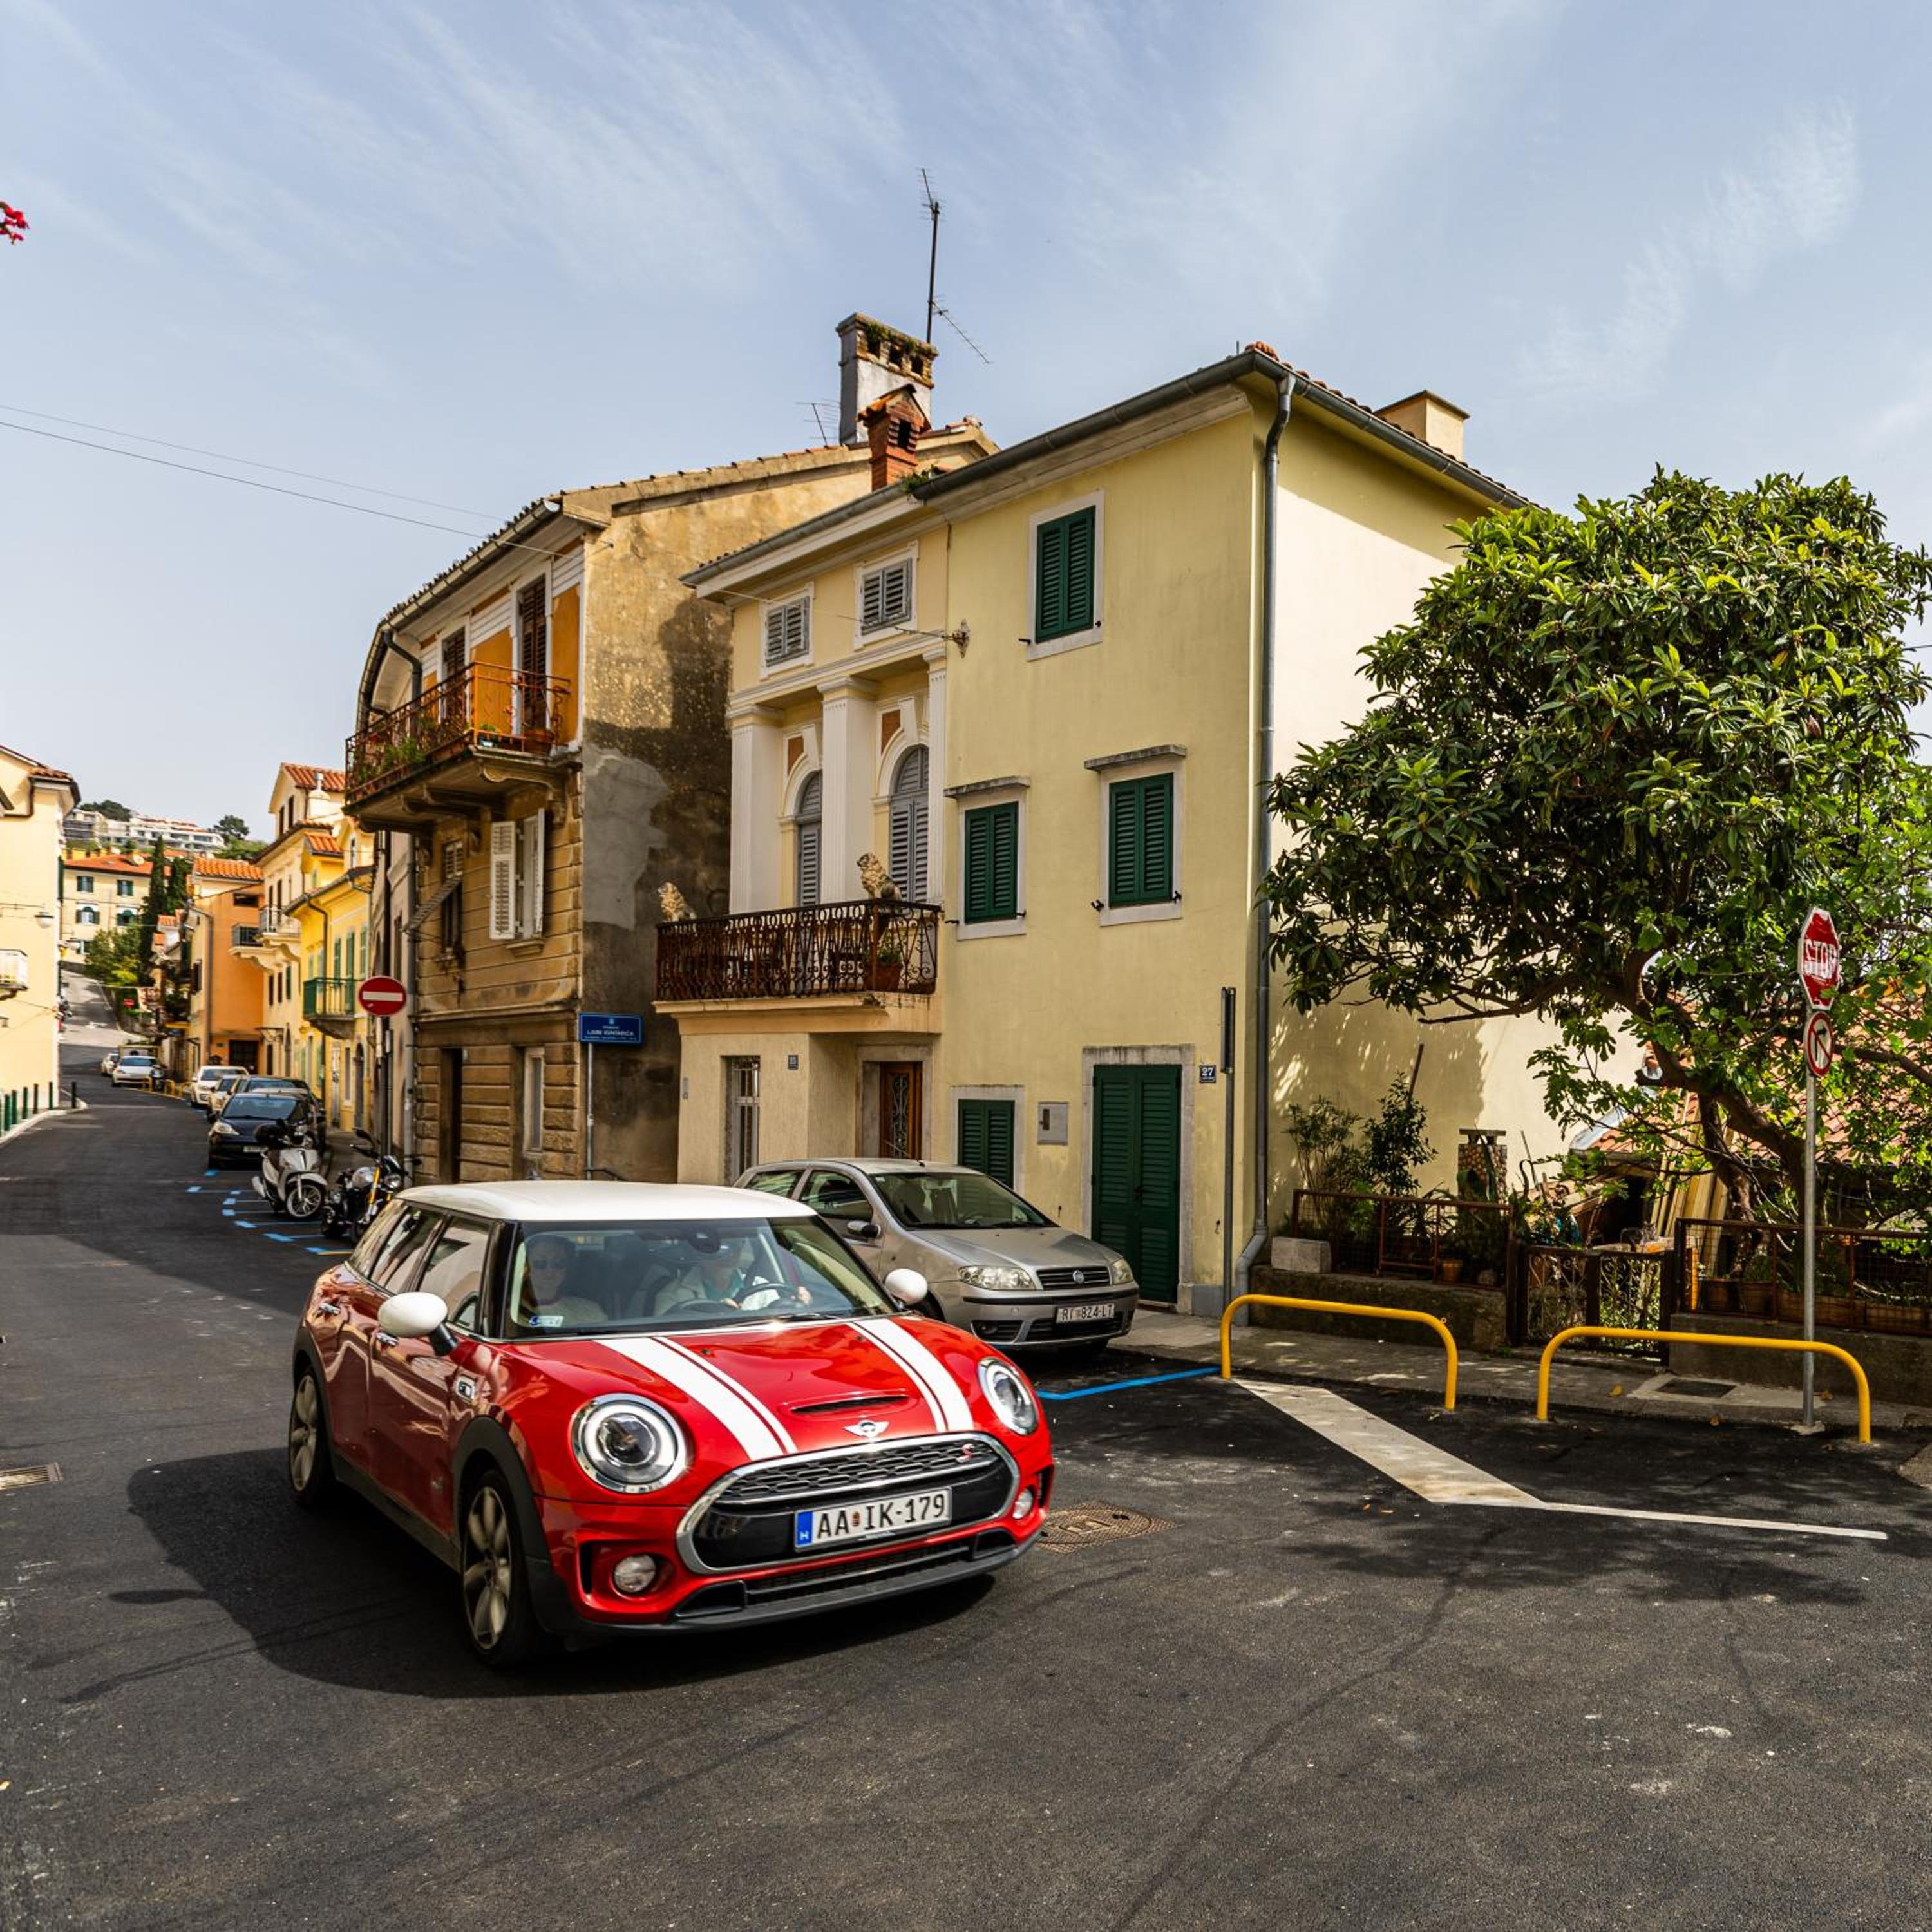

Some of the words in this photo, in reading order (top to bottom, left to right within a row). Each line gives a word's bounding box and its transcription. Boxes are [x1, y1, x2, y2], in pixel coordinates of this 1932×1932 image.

[1804, 938, 1837, 980] STOP
[1202, 1067, 1213, 1076] 27
[817, 1510, 849, 1539] AA
[864, 1493, 945, 1530] IK-179
